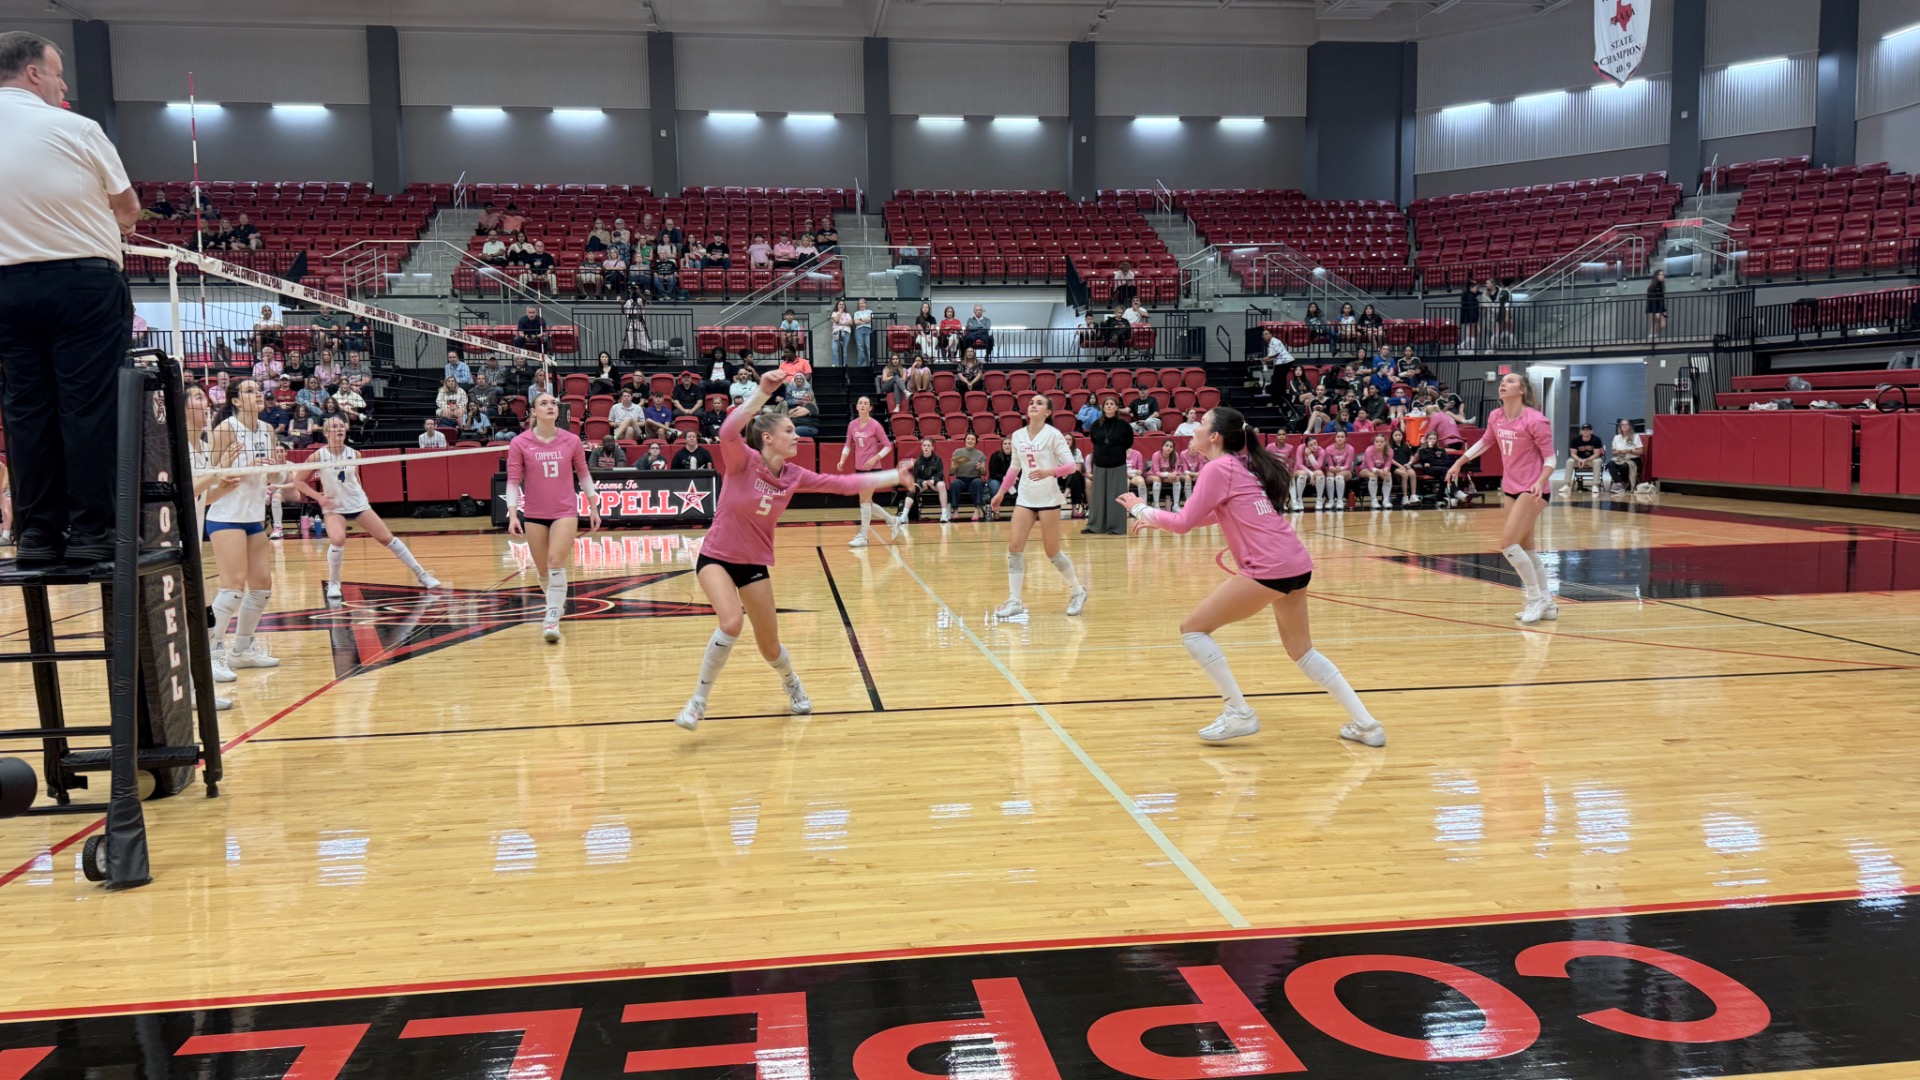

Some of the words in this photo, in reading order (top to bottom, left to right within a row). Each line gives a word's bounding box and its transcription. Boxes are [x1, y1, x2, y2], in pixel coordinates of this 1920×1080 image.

[1610, 34, 1634, 51] STATE
[1599, 44, 1642, 66] CHAMPION
[535, 451, 563, 461] COPPELL
[1501, 439, 1513, 456] 17
[542, 461, 559, 478] 13
[1026, 453, 1037, 469] 2
[337, 470, 346, 483] 4
[625, 479, 638, 490] To
[576, 489, 678, 517] PPELL
[755, 494, 774, 516] 5
